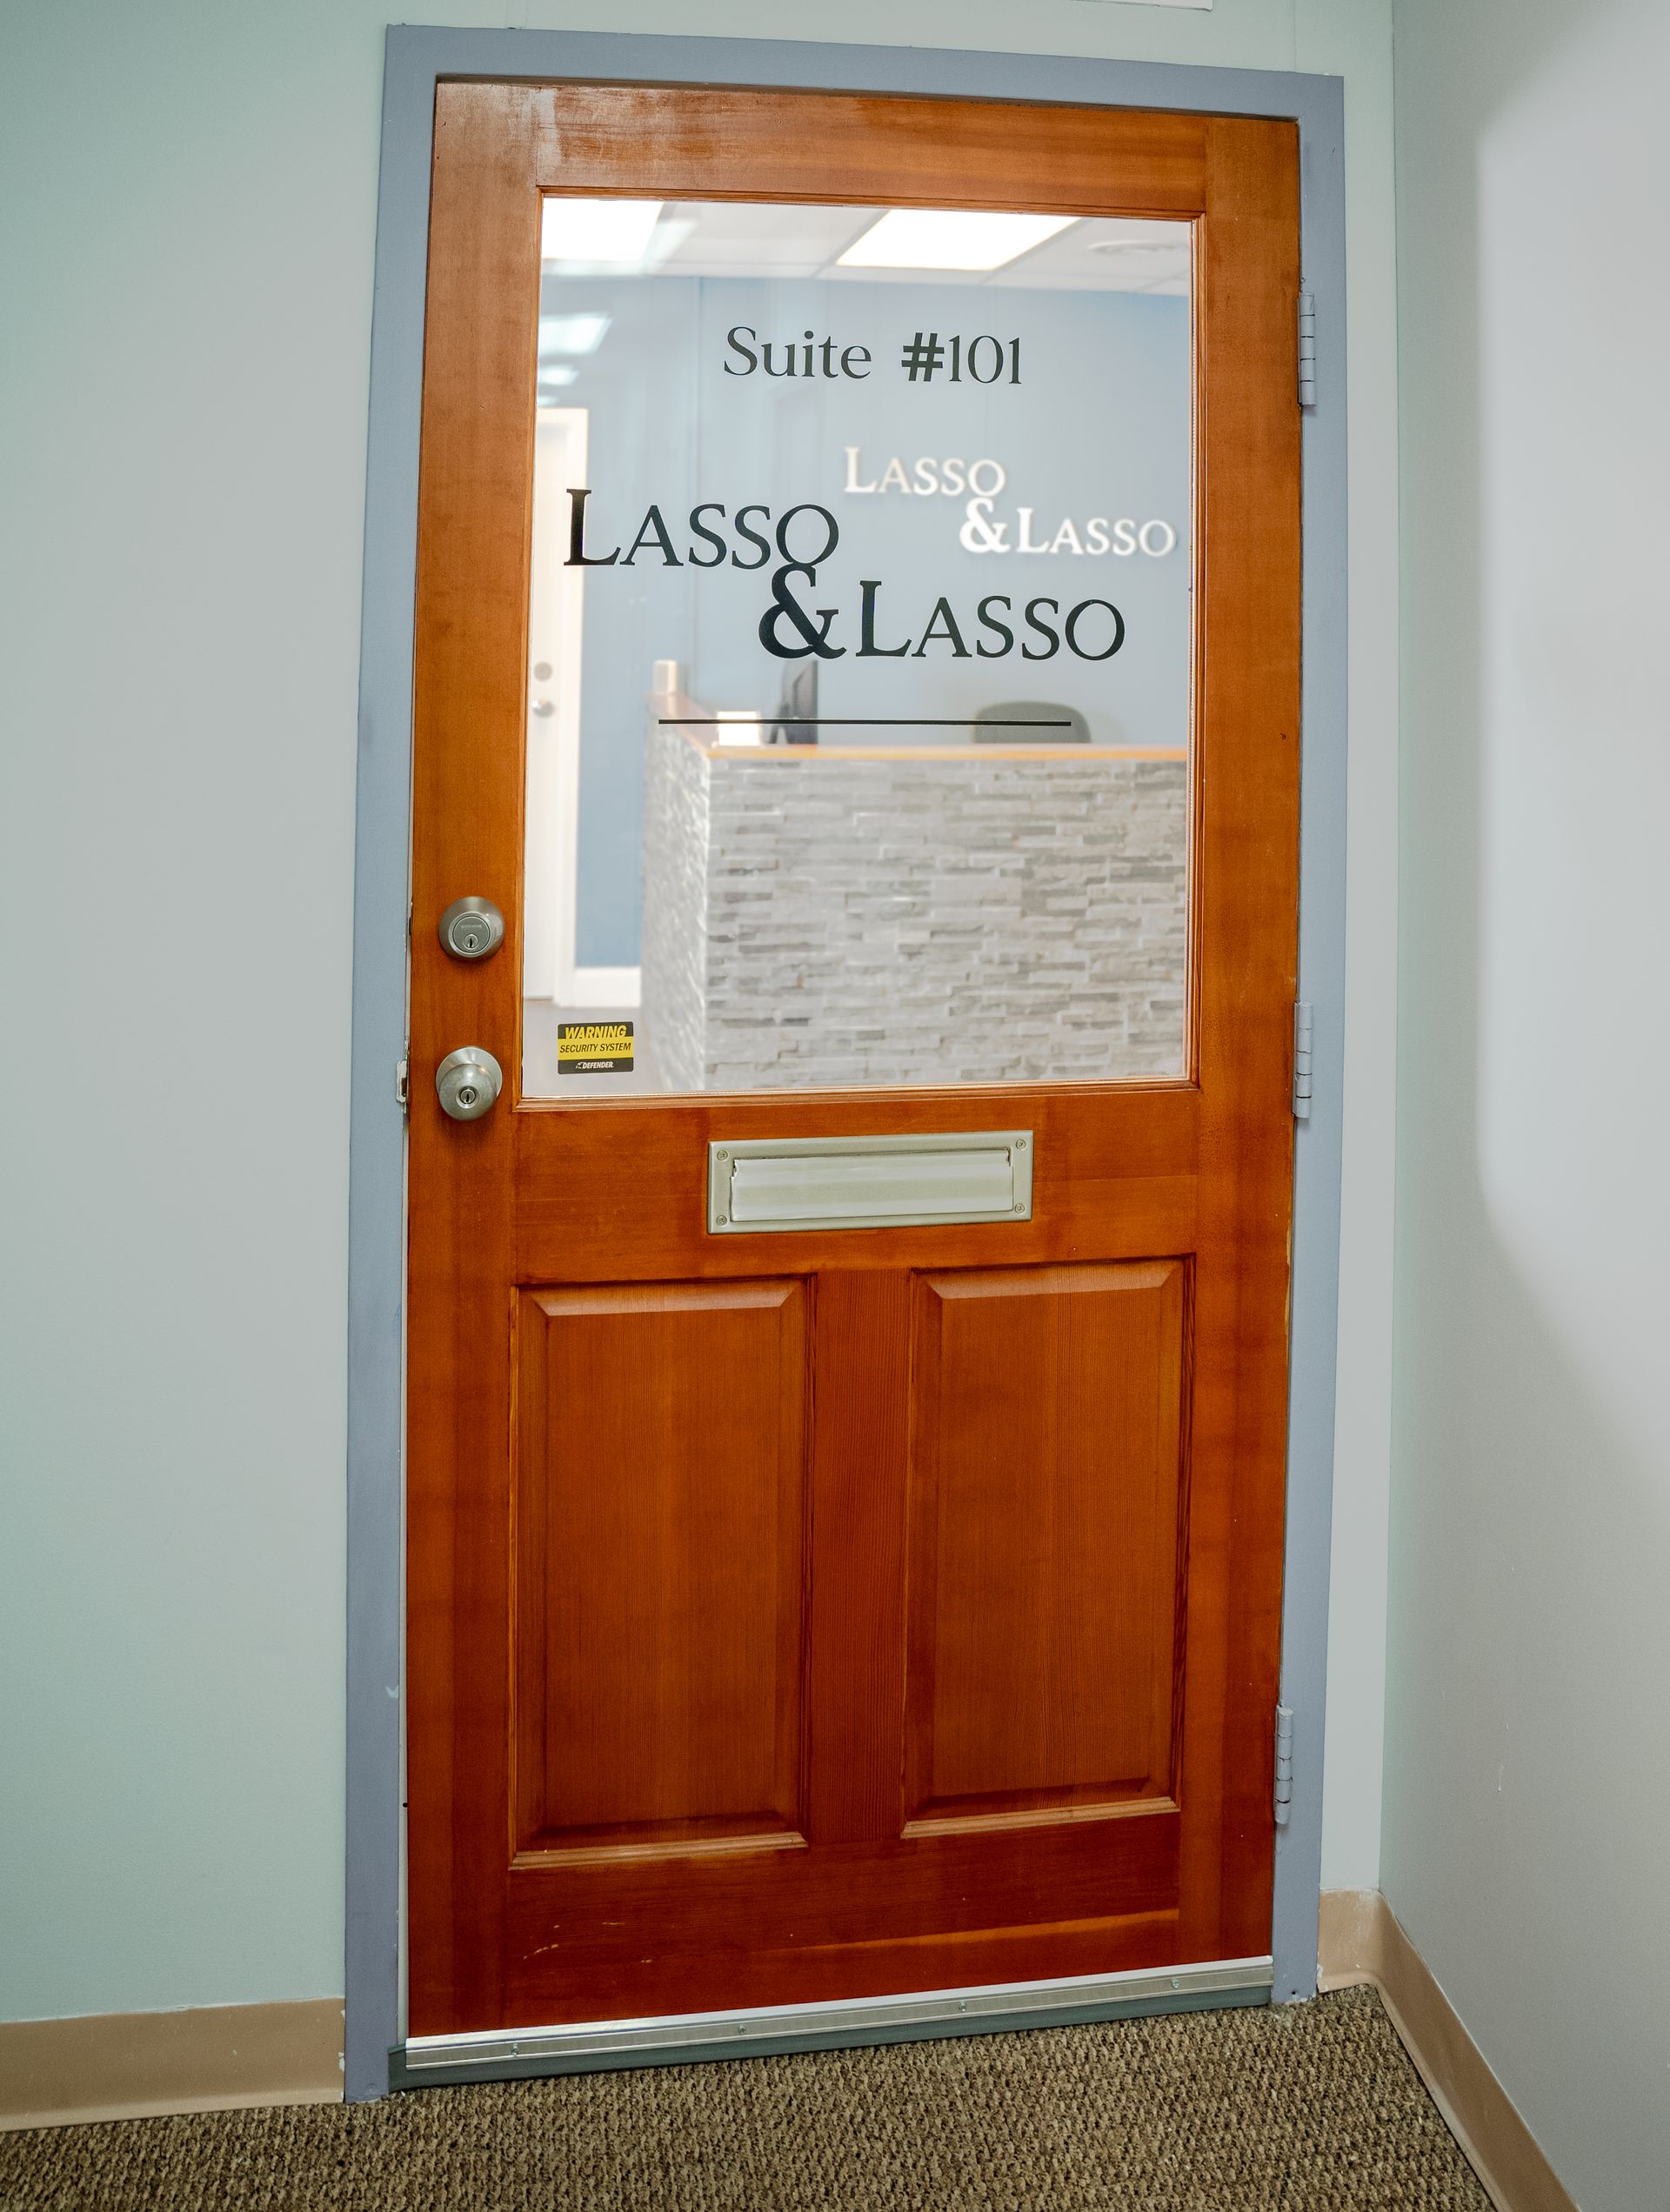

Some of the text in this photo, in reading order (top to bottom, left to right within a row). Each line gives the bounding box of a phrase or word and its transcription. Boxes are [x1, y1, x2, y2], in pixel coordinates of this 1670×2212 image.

[724, 326, 1022, 384] Suite #101
[844, 447, 1005, 497] LASSO
[564, 489, 839, 568] LASSO
[1016, 508, 1176, 557] LASSO
[856, 580, 1126, 660] LASSO
[559, 1042, 631, 1053] SECURITY SYSTEM
[564, 1025, 627, 1039] WARNING
